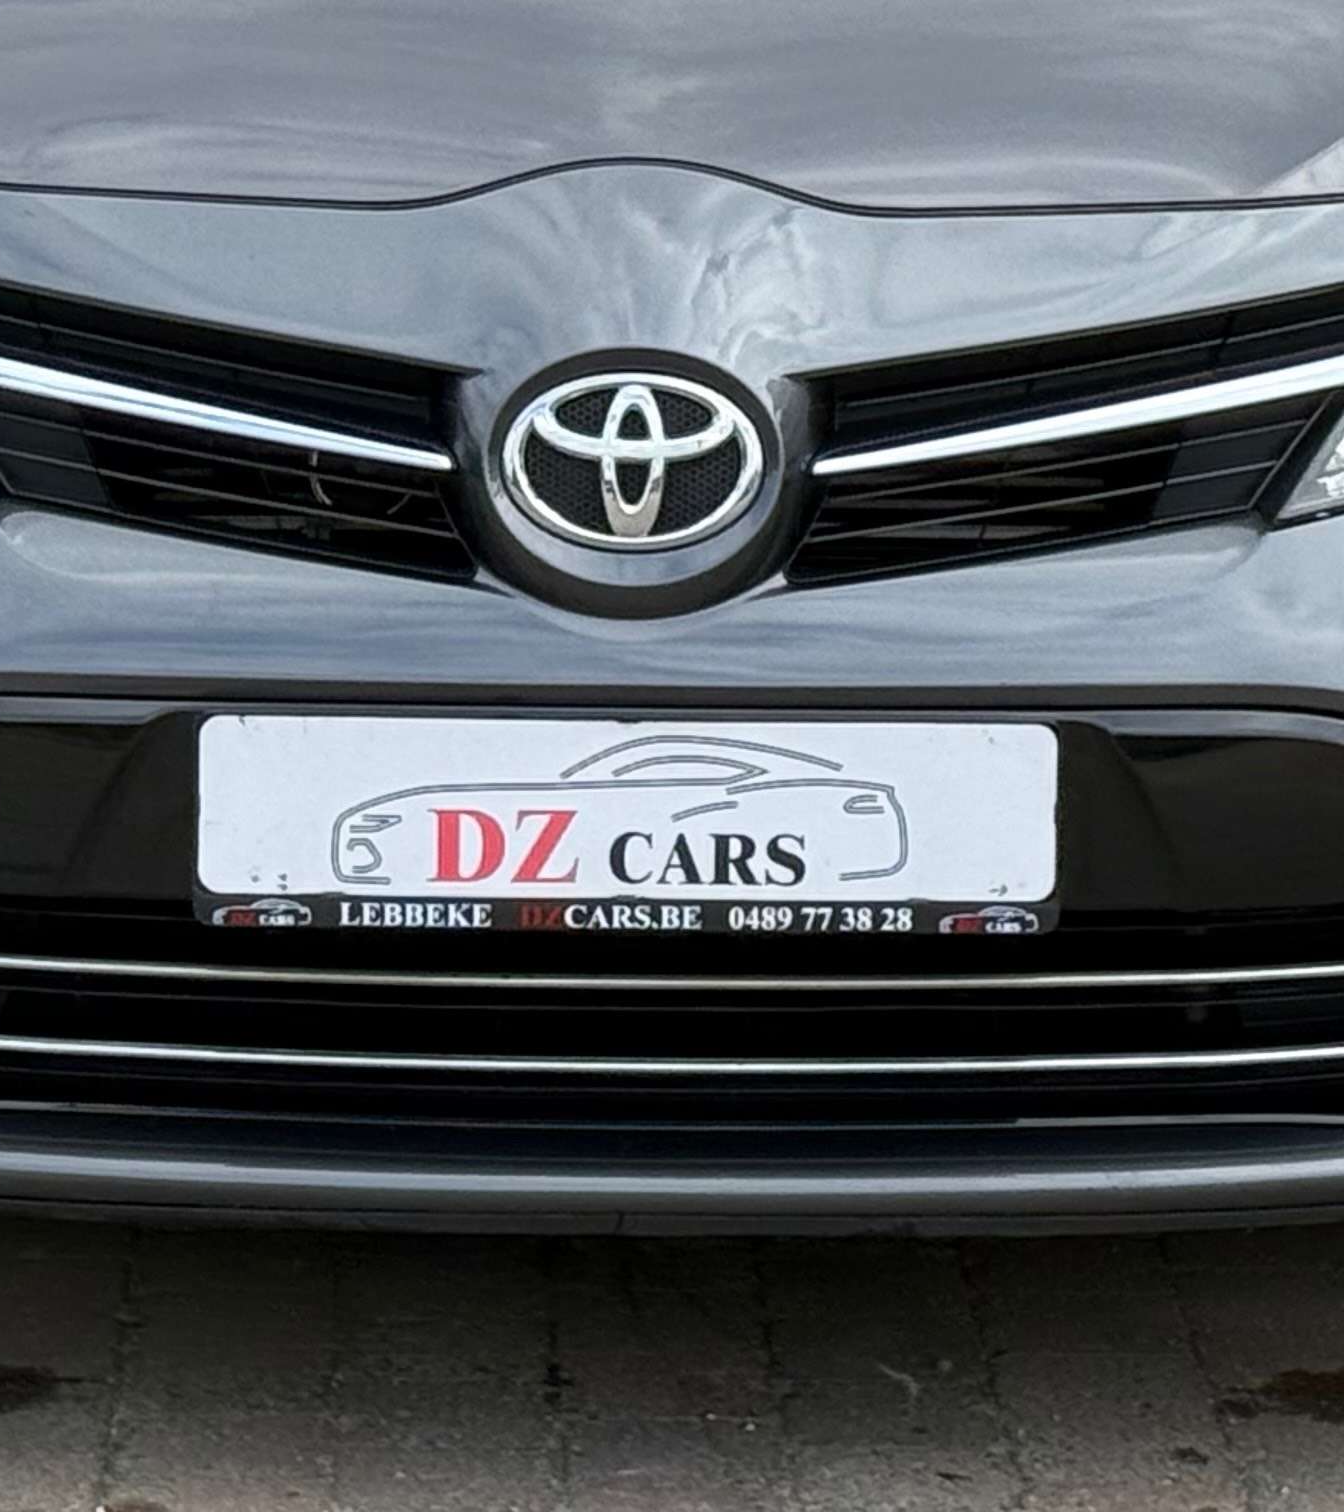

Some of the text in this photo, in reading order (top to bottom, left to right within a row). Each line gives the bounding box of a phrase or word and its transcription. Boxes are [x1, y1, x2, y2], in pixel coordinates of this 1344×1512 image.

[426, 808, 807, 887] DZ CARS
[339, 902, 492, 928] LEBBEKE
[728, 905, 793, 932] 0489
[800, 907, 834, 932] 77
[839, 907, 871, 932] 38
[881, 907, 914, 932] 28
